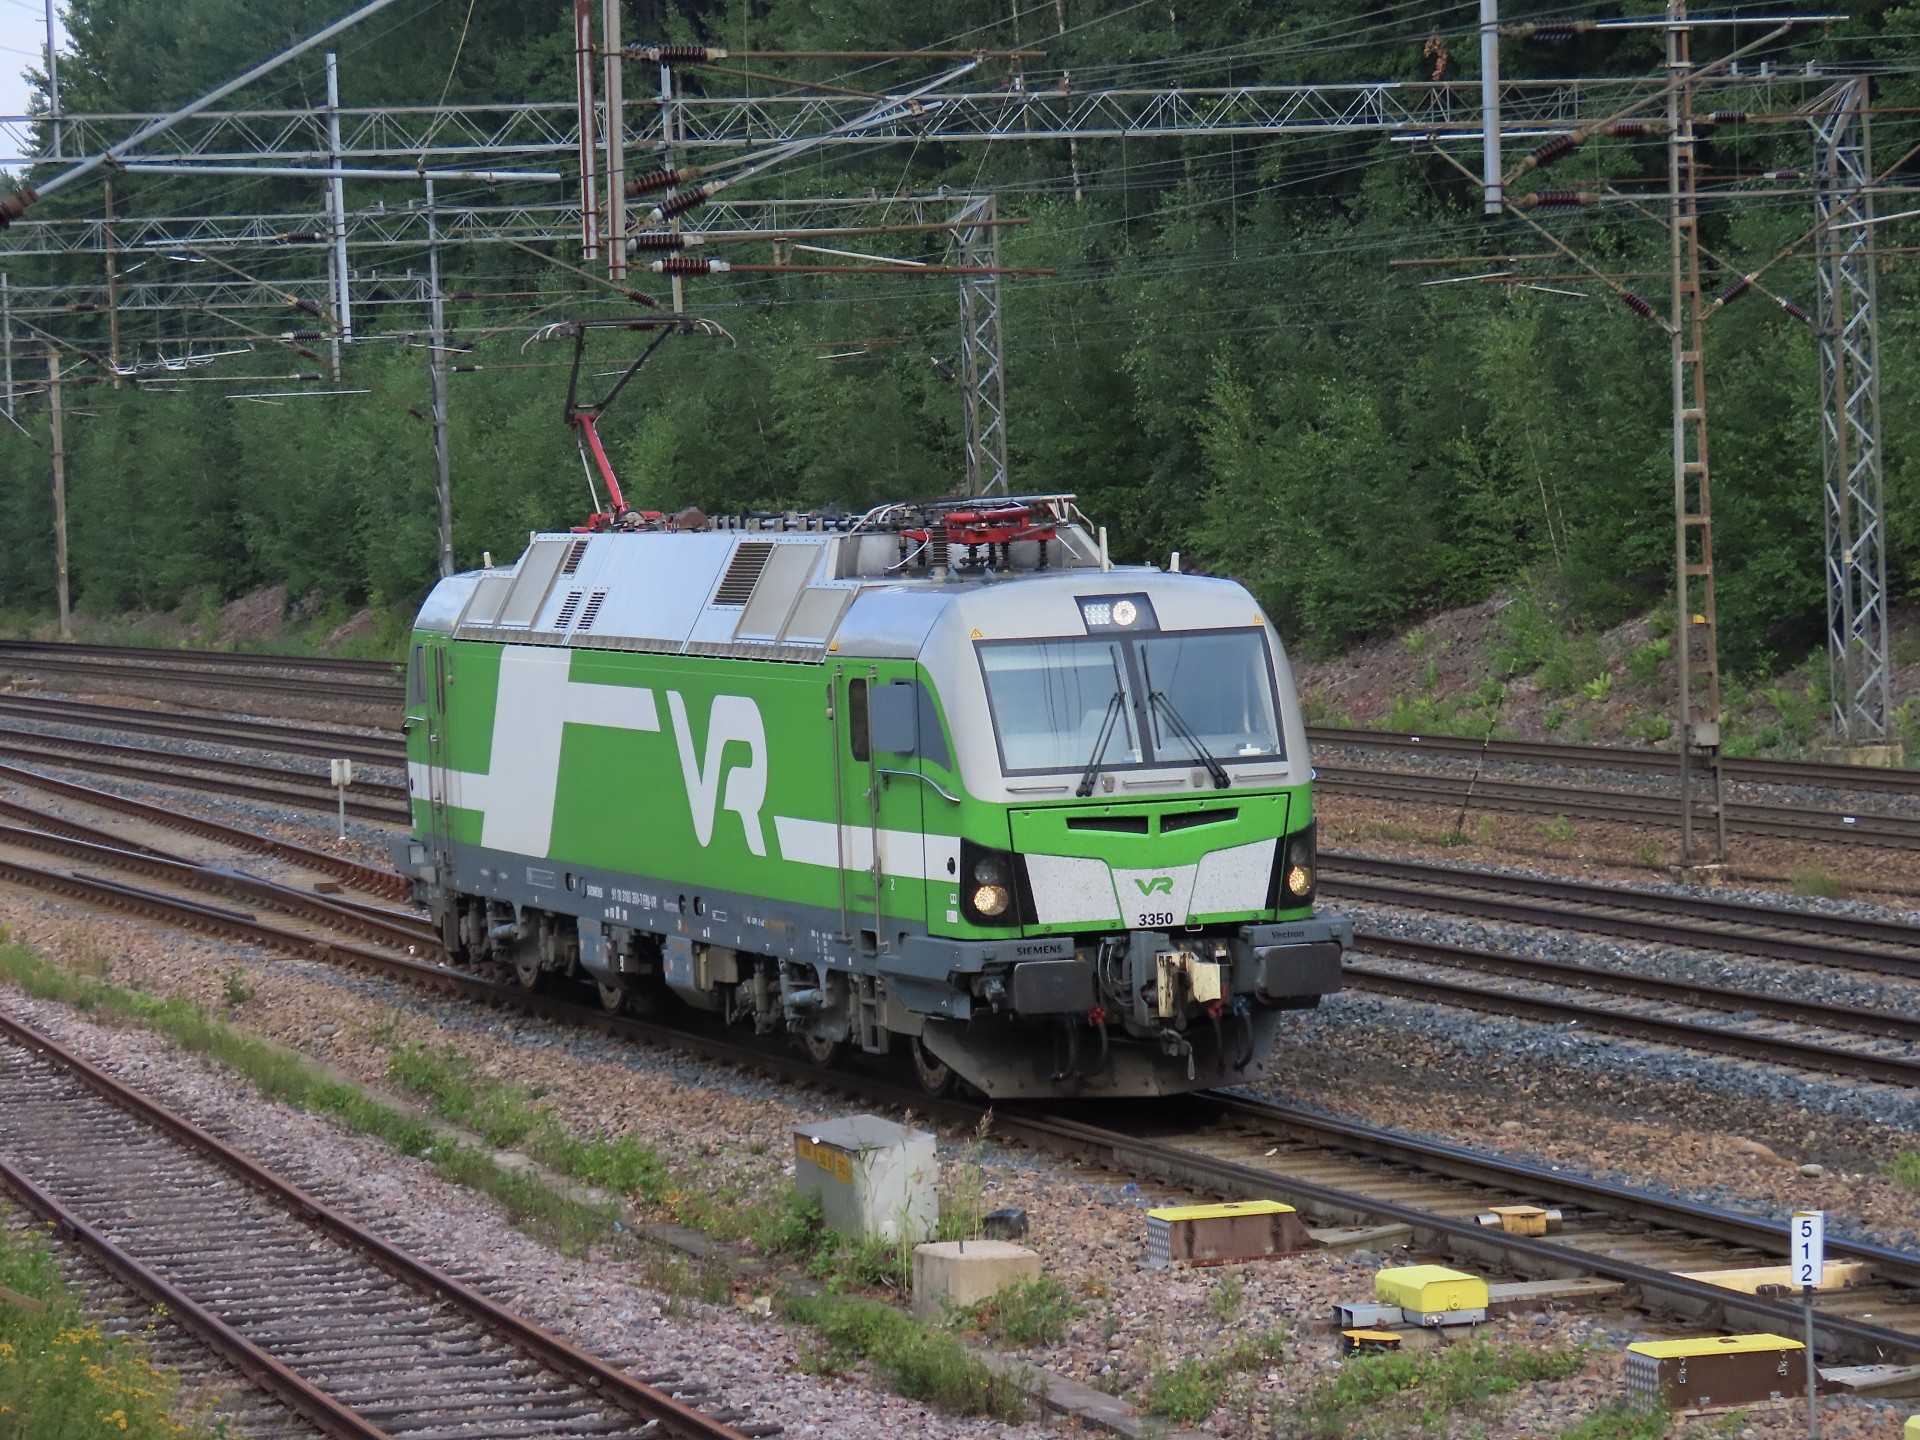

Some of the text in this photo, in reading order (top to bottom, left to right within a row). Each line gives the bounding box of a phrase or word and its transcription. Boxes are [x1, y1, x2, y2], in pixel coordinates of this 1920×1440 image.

[666, 690, 768, 857] VR
[891, 879, 895, 890] 2
[1134, 876, 1174, 896] VR
[1138, 912, 1174, 927] 3350
[1271, 930, 1305, 939] Vectron
[1016, 944, 1064, 956] SIEMENS
